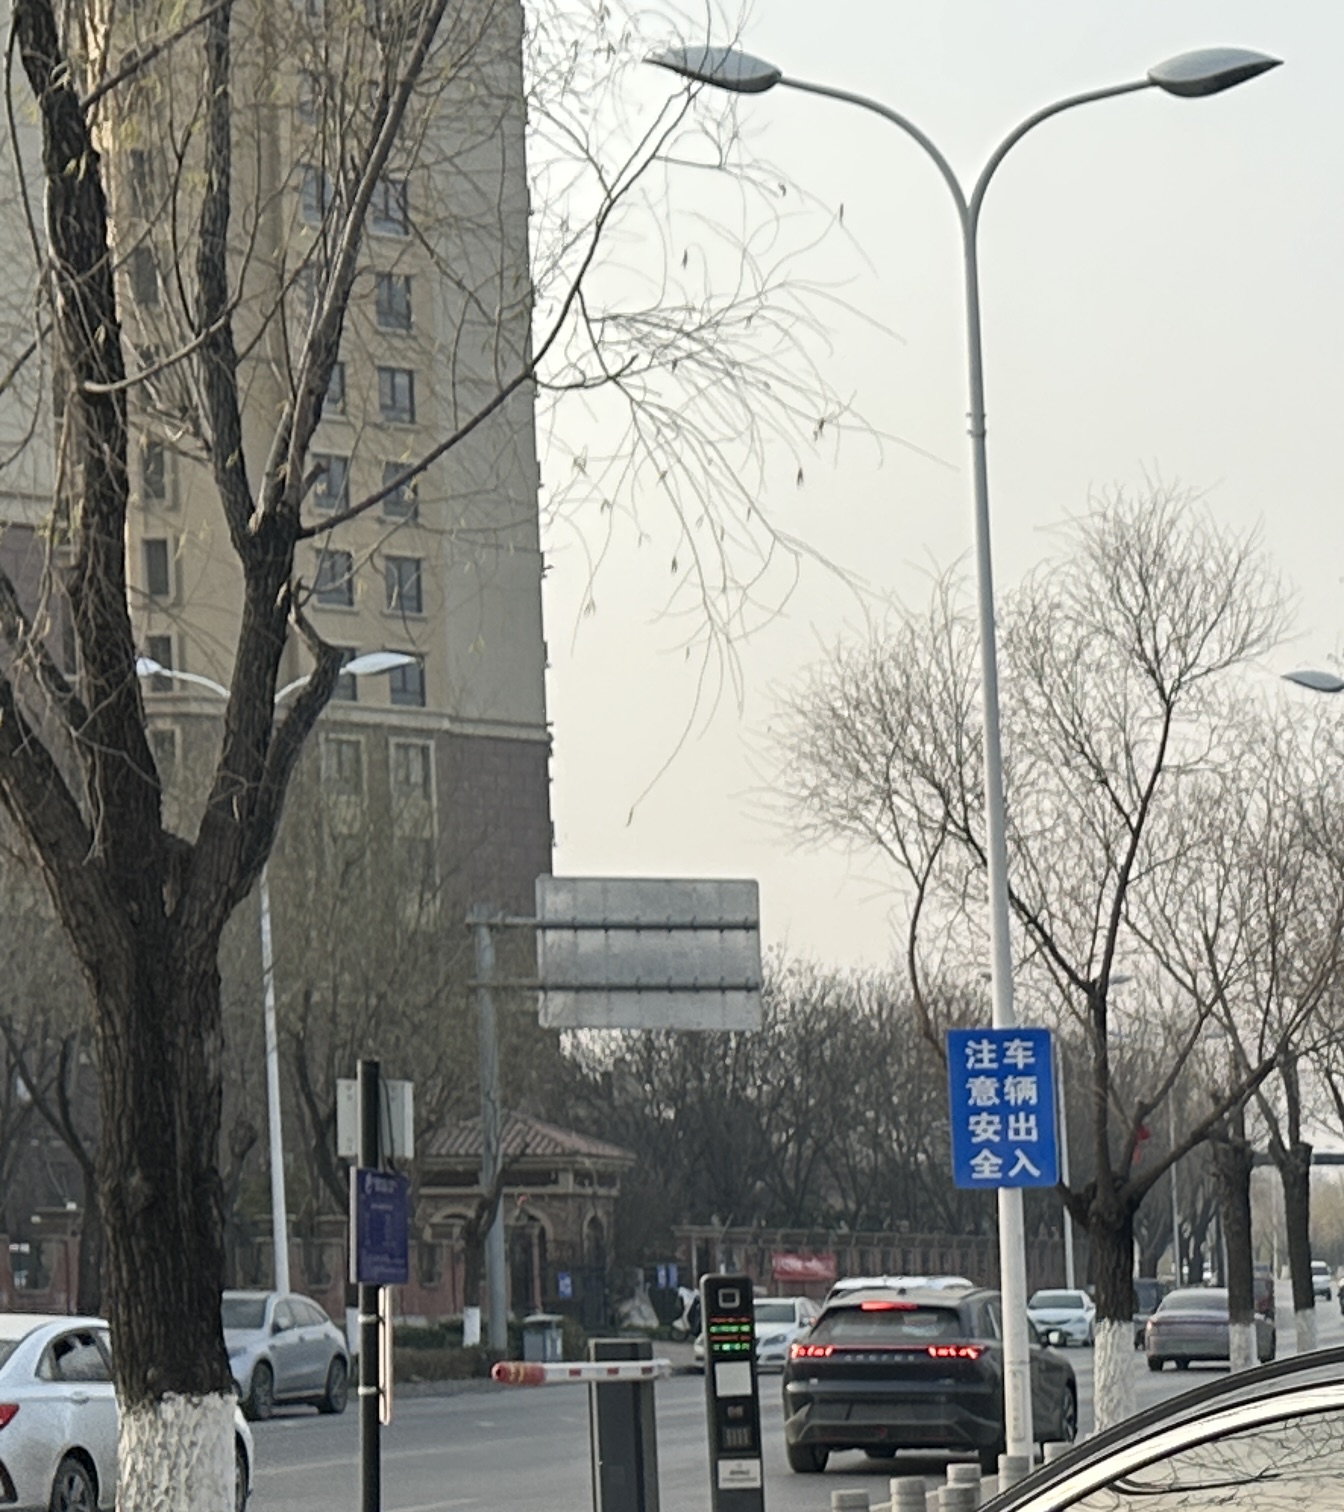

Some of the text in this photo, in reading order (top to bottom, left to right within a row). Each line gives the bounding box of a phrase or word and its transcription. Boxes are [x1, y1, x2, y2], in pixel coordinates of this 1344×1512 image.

[964, 1038, 1003, 1179] 注意安全
[1002, 1038, 1041, 1178] 车辆出入
